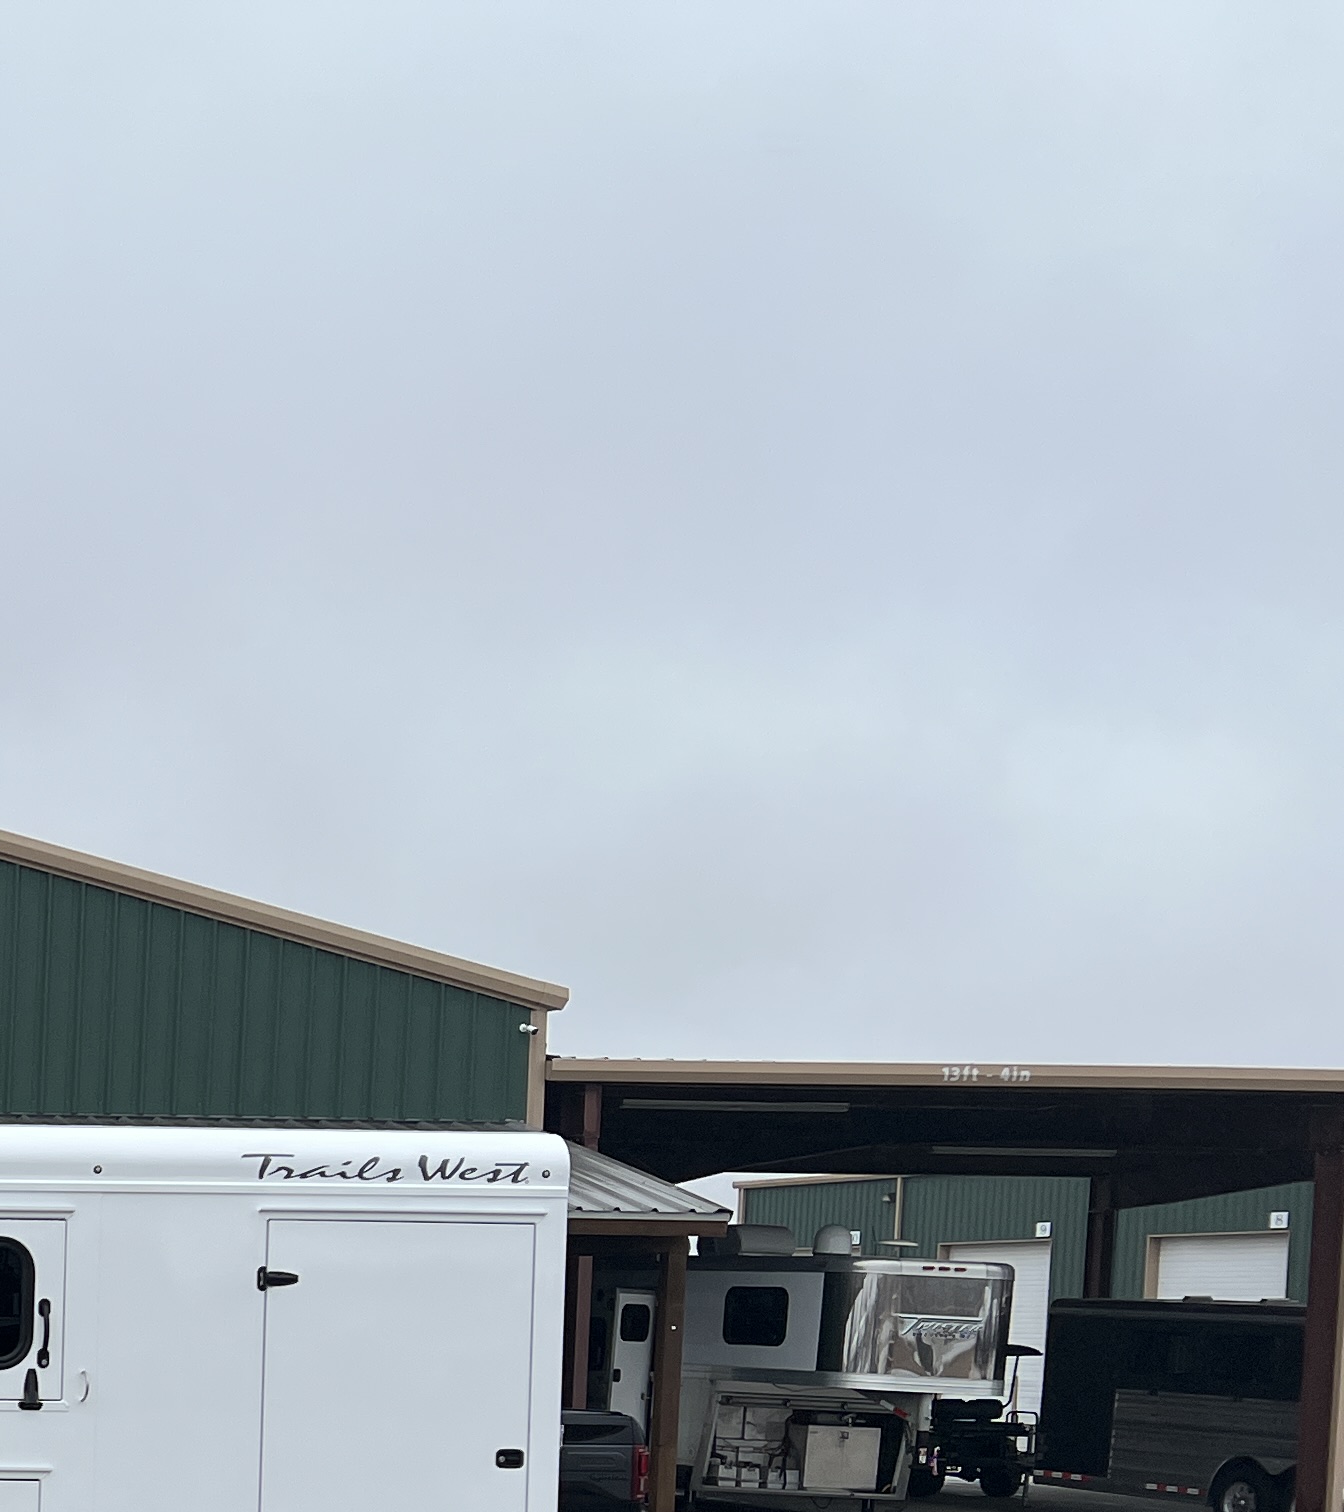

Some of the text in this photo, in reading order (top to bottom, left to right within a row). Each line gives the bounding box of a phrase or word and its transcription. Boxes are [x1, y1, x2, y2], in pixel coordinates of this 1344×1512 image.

[941, 1065, 980, 1082] 13ft
[999, 1066, 1031, 1082] 4in
[241, 1153, 530, 1184] Trails West
[1274, 1213, 1284, 1226] 8
[1040, 1224, 1048, 1236] 9
